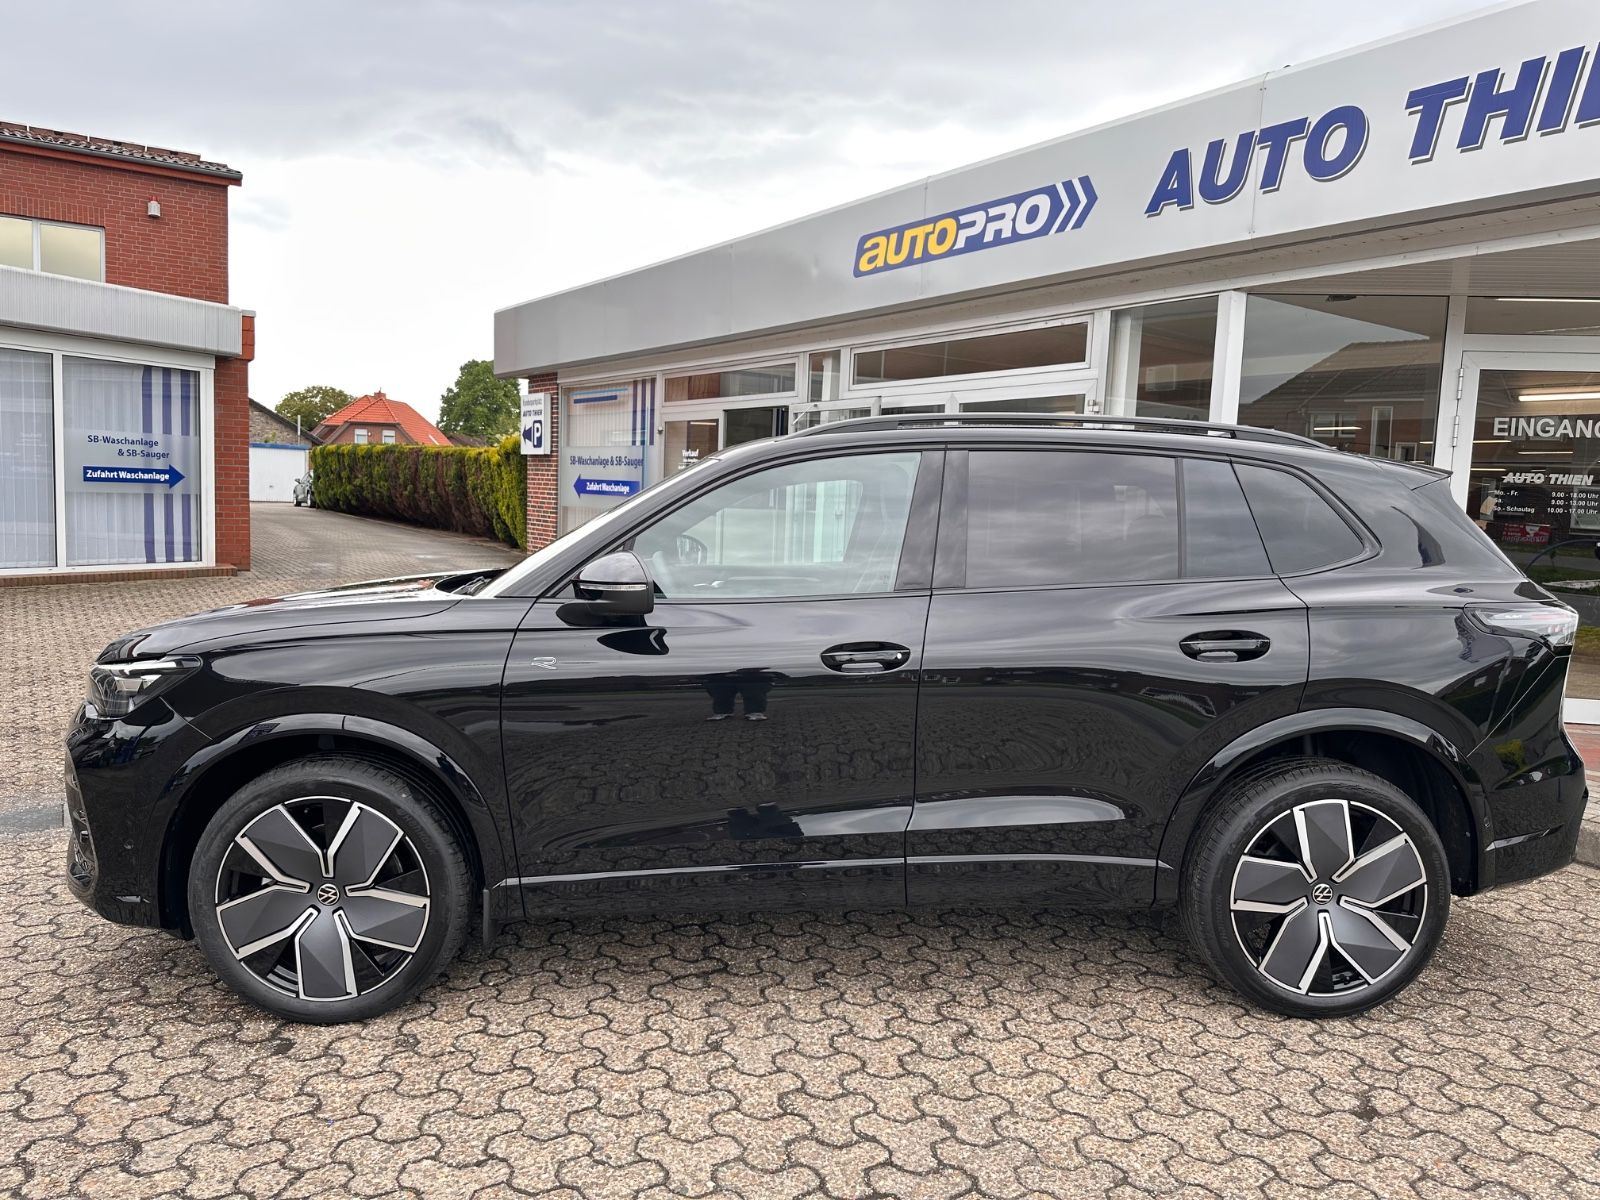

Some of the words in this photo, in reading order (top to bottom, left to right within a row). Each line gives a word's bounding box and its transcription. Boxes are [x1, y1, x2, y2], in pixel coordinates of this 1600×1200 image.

[1144, 105, 1370, 218] AUTO
[1404, 40, 1600, 166] THI
[87, 434, 159, 448] SB-Waschanlage
[117, 448, 124, 457] &
[126, 449, 169, 460] SB-Sauger
[570, 456, 609, 468] SB-Waschanlage
[615, 456, 643, 470] SB-Sauger
[86, 469, 118, 479] Zufahrt
[119, 471, 170, 481] Waschanlage
[1502, 472, 1545, 484] AUTO
[1549, 473, 1594, 486] THIEN
[586, 482, 601, 491] Zufahrt
[602, 483, 630, 494] Waschanlage
